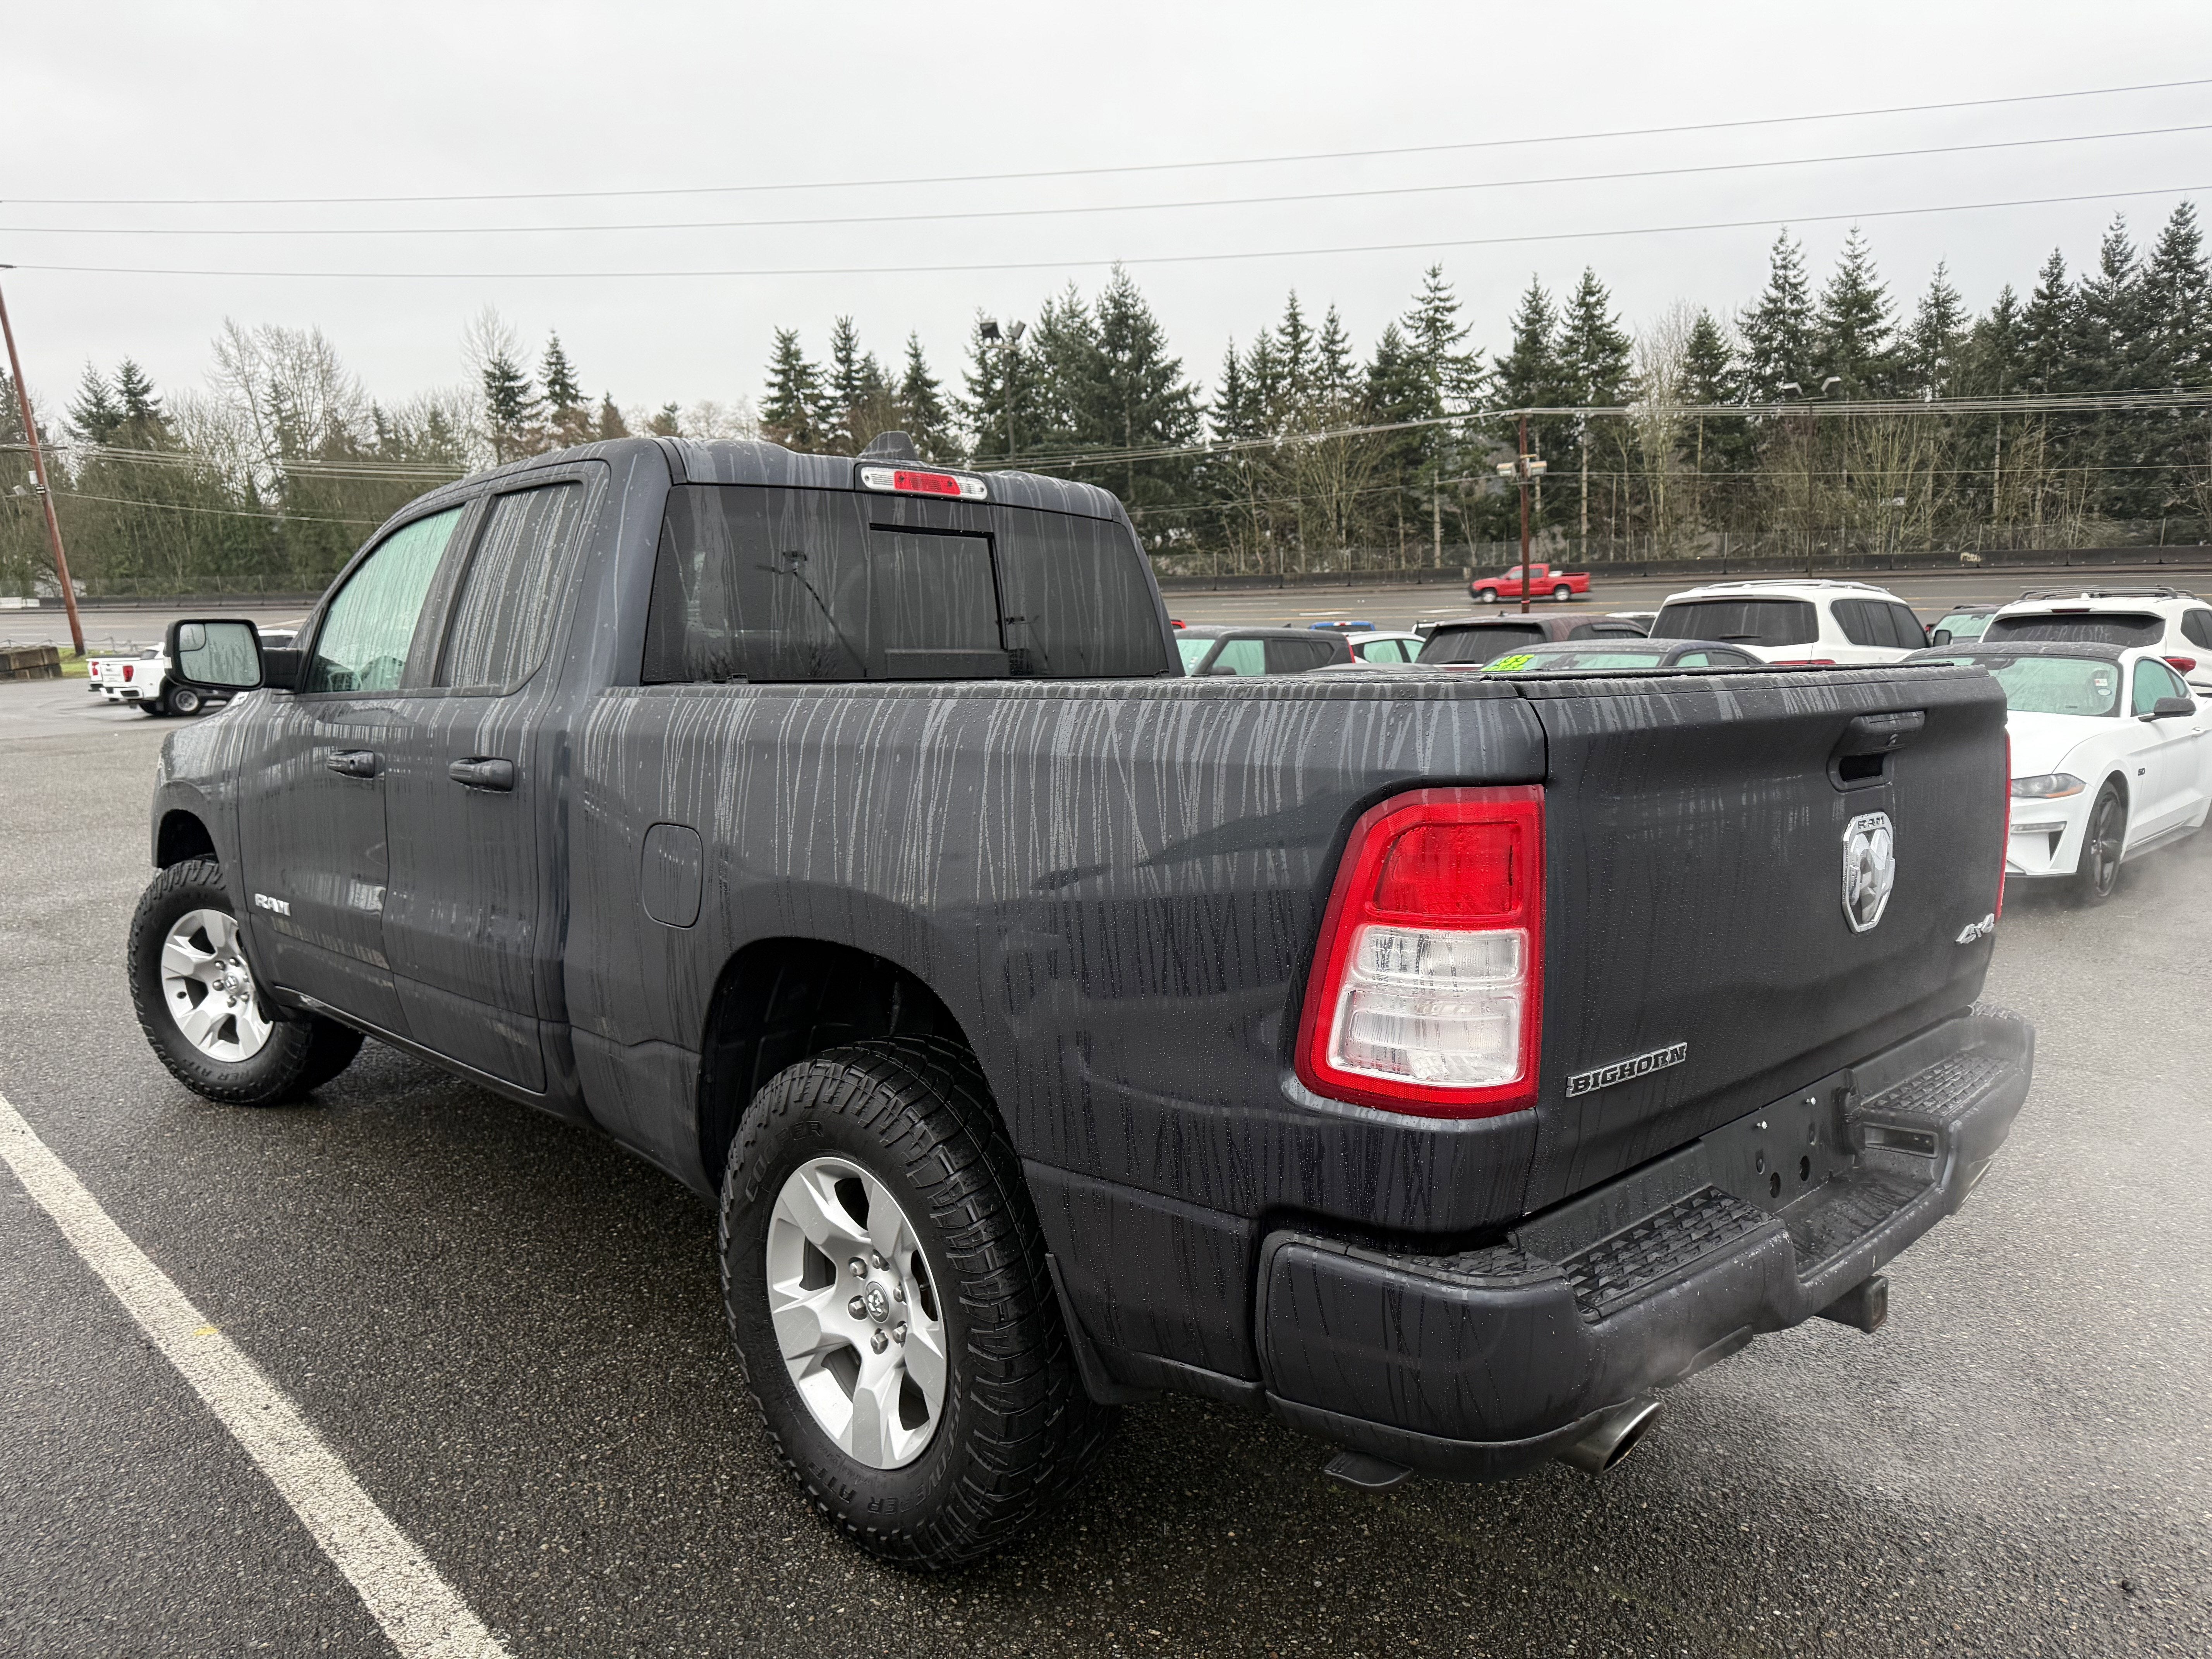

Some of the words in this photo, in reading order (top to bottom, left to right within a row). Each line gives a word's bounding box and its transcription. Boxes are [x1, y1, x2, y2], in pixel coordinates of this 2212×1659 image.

[1858, 816, 1884, 829] RAM
[254, 893, 291, 917] RAM
[1565, 1042, 1688, 1097] BIGHORN
[745, 1120, 825, 1203] COOPER
